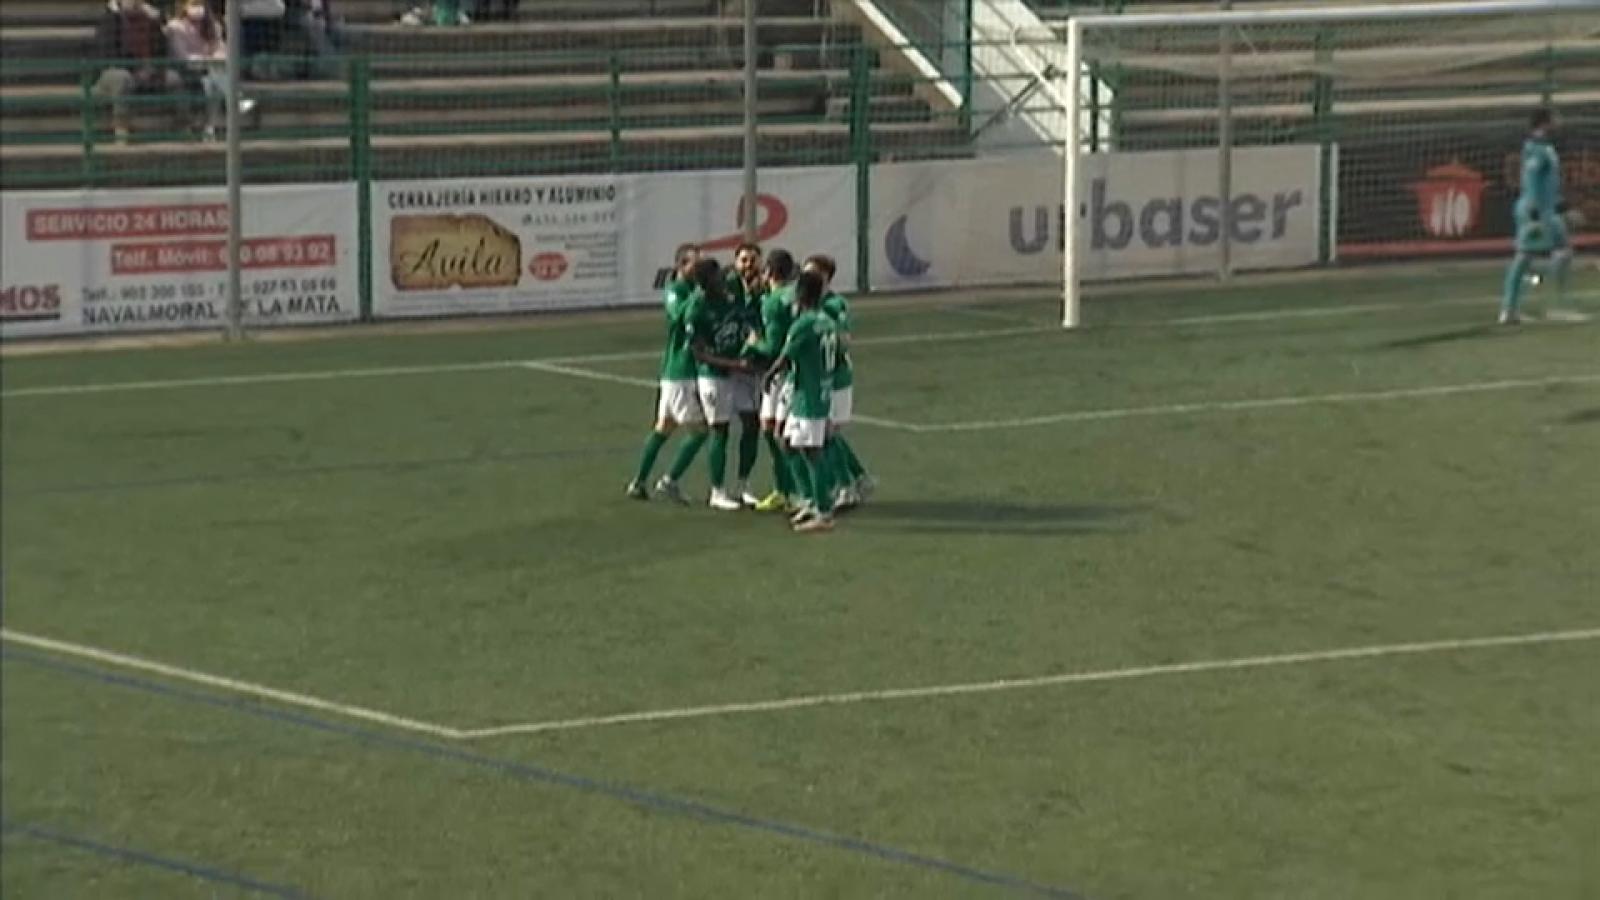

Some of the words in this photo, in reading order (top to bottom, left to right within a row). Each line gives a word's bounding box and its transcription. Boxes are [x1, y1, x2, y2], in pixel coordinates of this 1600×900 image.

[388, 187, 475, 209] CERRAJERÍA
[480, 187, 530, 206] HIERRO
[534, 186, 546, 203] Y
[549, 184, 616, 204] ALUMINIO
[33, 211, 130, 234] SERVICIO
[133, 211, 155, 231] 24
[160, 208, 230, 230] HORAS
[82, 301, 219, 326] NAVALMORAL
[257, 297, 283, 317] LA
[287, 294, 341, 314] MATA
